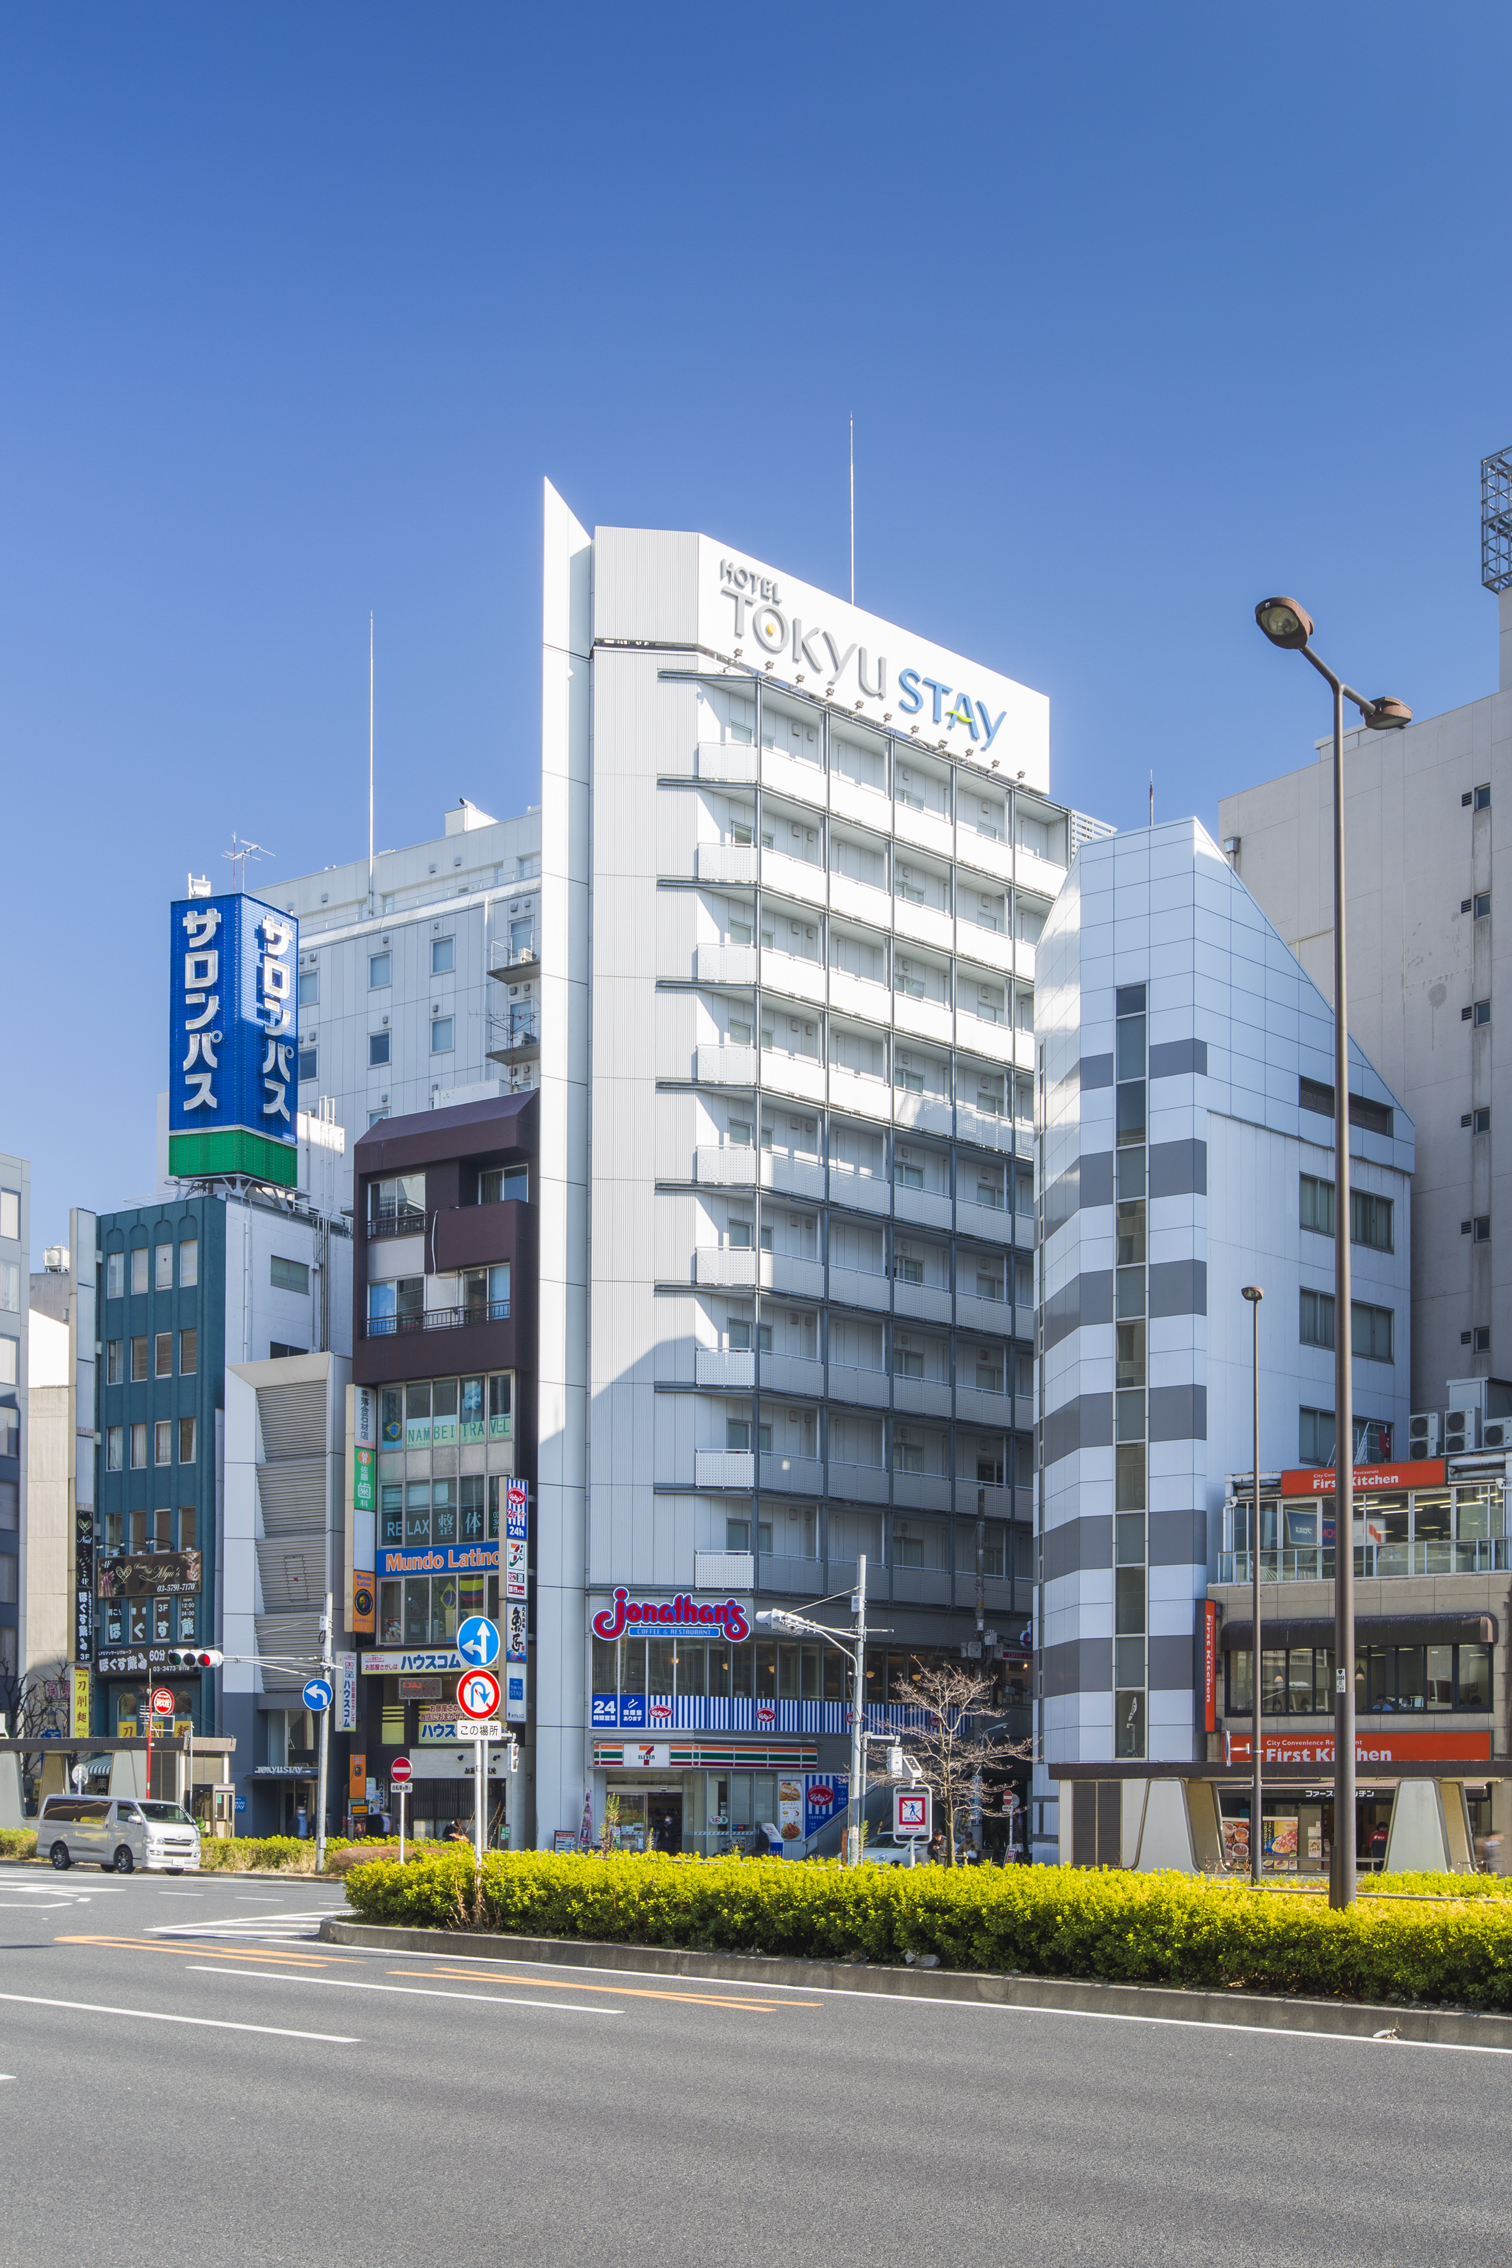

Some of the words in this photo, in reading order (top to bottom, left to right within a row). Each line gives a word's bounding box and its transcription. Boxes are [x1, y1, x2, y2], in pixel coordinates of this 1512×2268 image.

[720, 558, 783, 604] HOTEL
[721, 585, 888, 700] TOKYU
[898, 667, 1008, 751] STAY
[182, 908, 223, 1111] サロンパス
[262, 914, 295, 1122] サロンパス
[408, 1425, 454, 1442] NAMBEI
[462, 1419, 510, 1438] TRAVEL
[1313, 1478, 1336, 1489] Firs
[387, 1519, 430, 1537] RELAX
[437, 1512, 482, 1536] 整体
[509, 1525, 525, 1537] 24h
[385, 1551, 445, 1573] Mundo
[448, 1548, 499, 1569] Latino
[157, 1604, 169, 1612] 3F
[592, 1587, 750, 1642] jonathan's
[98, 1655, 138, 1673] ほぐす蔵
[149, 1649, 166, 1662] 60分
[400, 1653, 462, 1671] ハウスコム
[343, 1680, 351, 1728] ハウスコム
[593, 1701, 616, 1714] 24
[460, 1725, 499, 1736] この場所
[1266, 1748, 1311, 1762] First
[1315, 1748, 1392, 1762] Kihen
